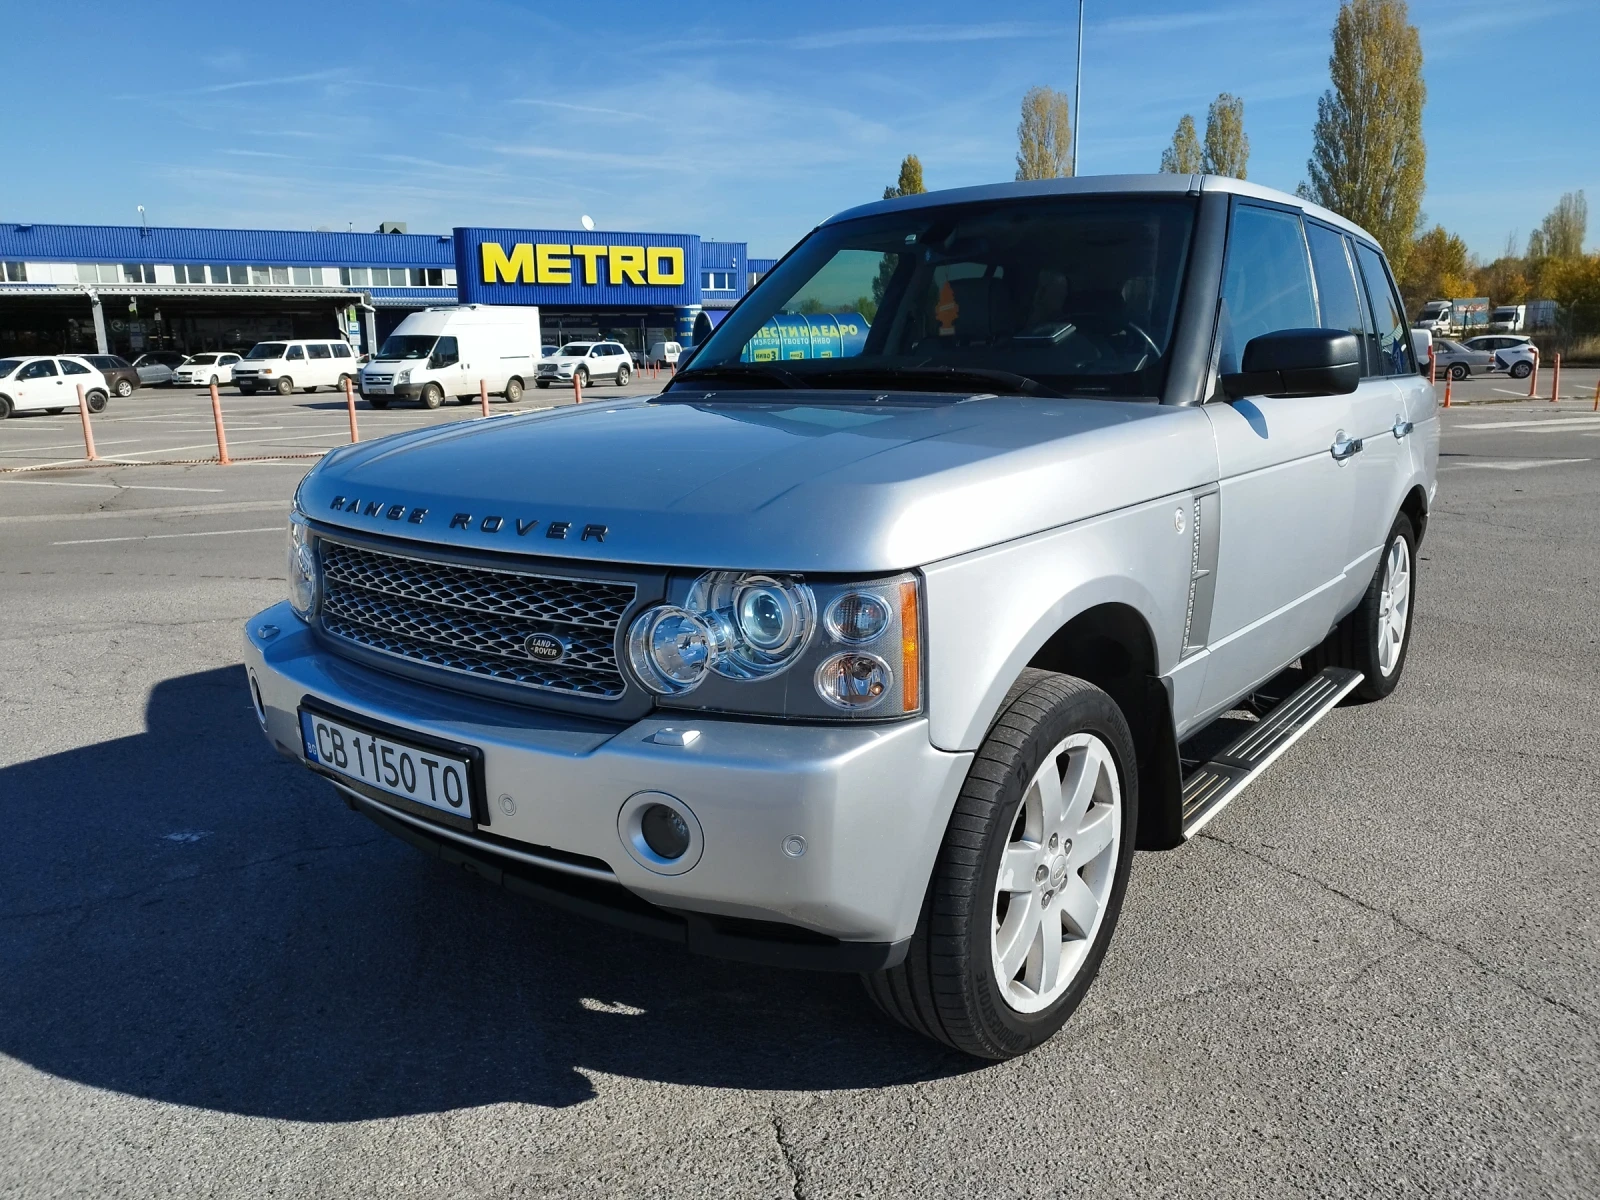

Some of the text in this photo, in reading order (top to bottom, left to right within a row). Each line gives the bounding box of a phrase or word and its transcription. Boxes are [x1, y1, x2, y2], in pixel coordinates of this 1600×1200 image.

[482, 242, 684, 285] METRO
[820, 324, 859, 338] ЕДРО
[771, 351, 777, 361] 3
[330, 495, 609, 543] RANGE ROVER
[532, 638, 552, 648] LAND
[534, 646, 557, 657] ROVER
[307, 741, 317, 755] BG
[316, 722, 463, 808] CB 1150 TO
